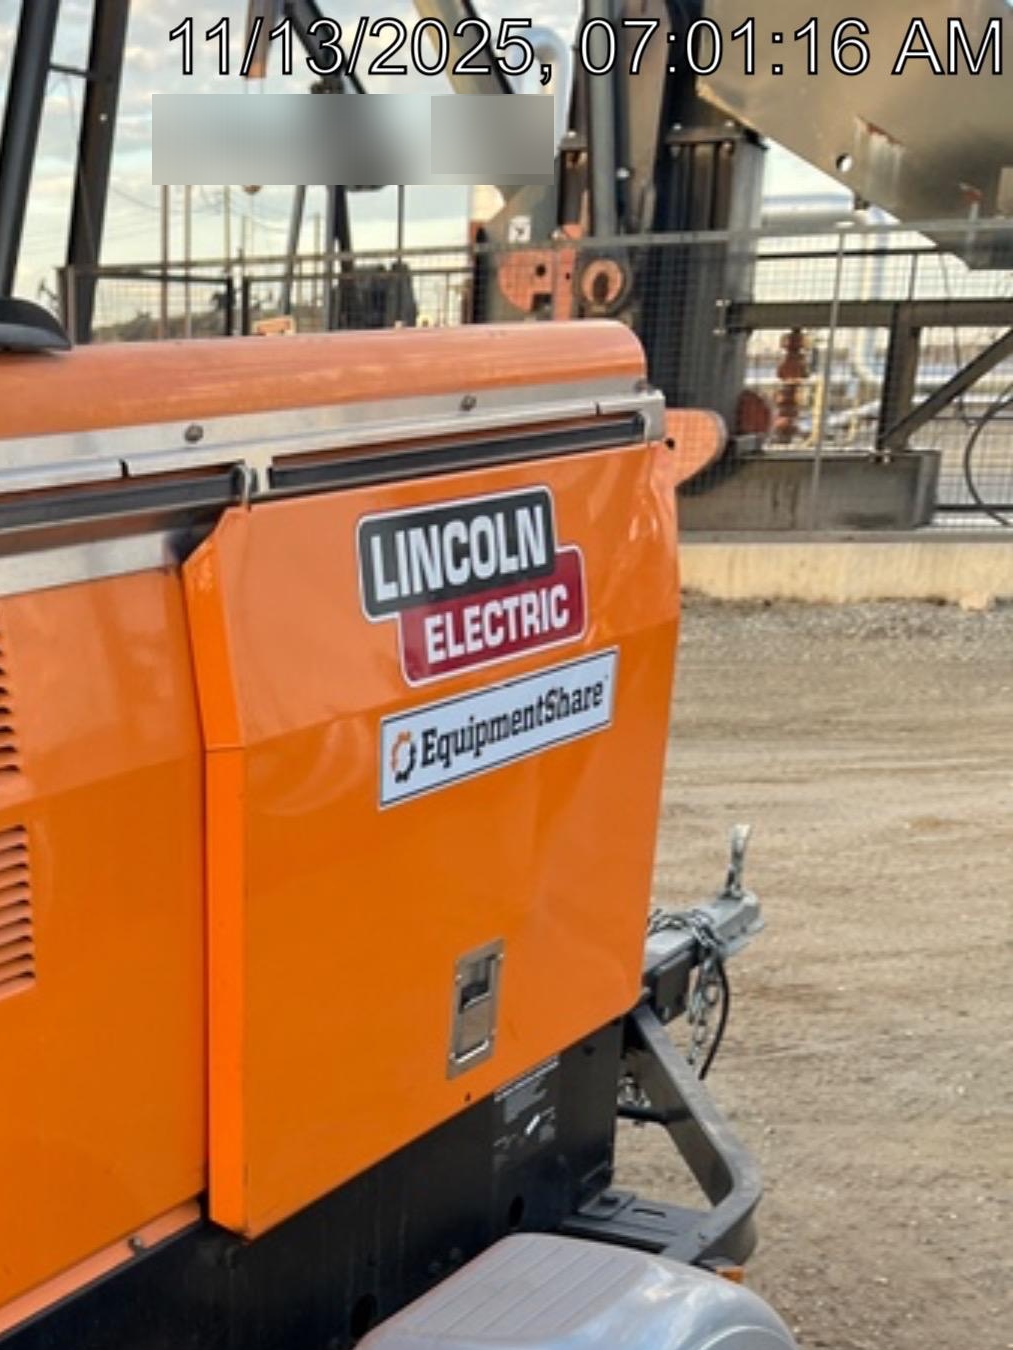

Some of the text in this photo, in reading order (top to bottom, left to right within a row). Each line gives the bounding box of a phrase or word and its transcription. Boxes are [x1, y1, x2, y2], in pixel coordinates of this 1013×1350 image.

[371, 505, 546, 602] LINCOLN
[424, 583, 570, 664] ELECTRIC
[421, 680, 604, 768] EquipmentShare
